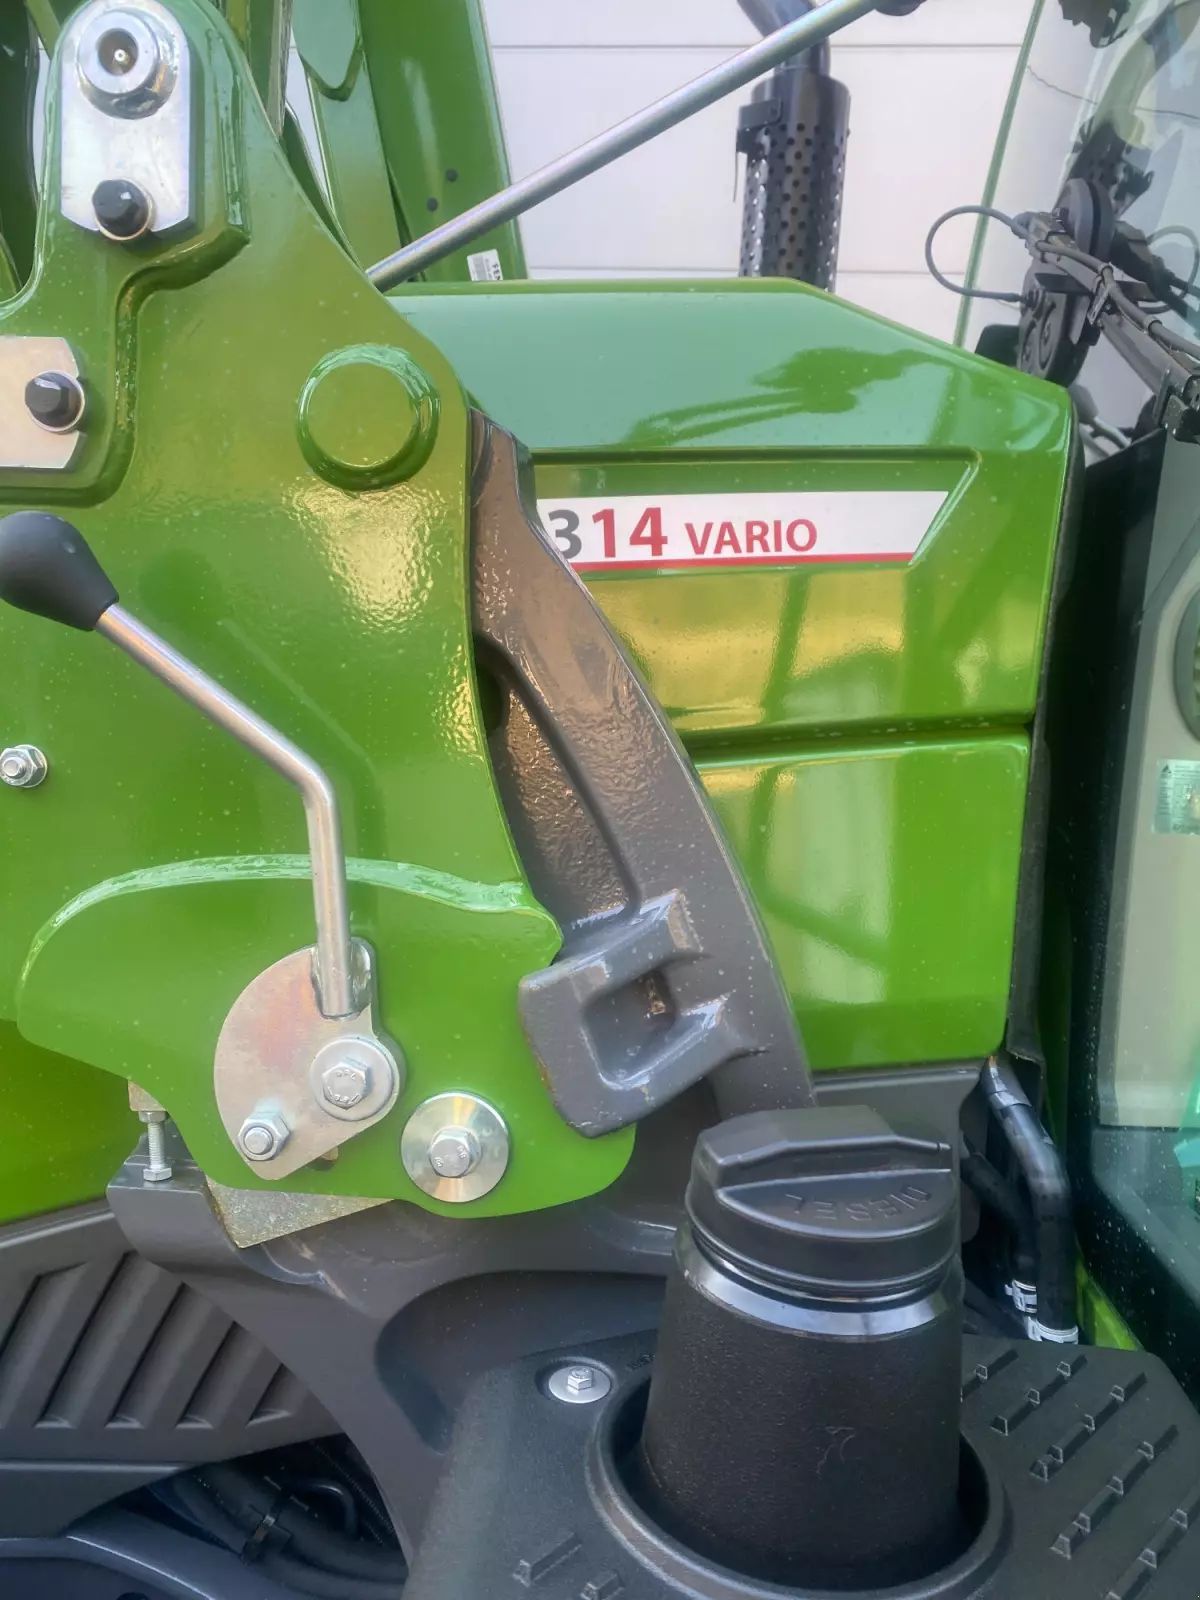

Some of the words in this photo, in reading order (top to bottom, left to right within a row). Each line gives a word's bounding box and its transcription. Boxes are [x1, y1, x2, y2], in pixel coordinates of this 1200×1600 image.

[548, 507, 668, 559] 314
[684, 518, 818, 555] VARIO
[785, 1185, 931, 1221] DIESEL
